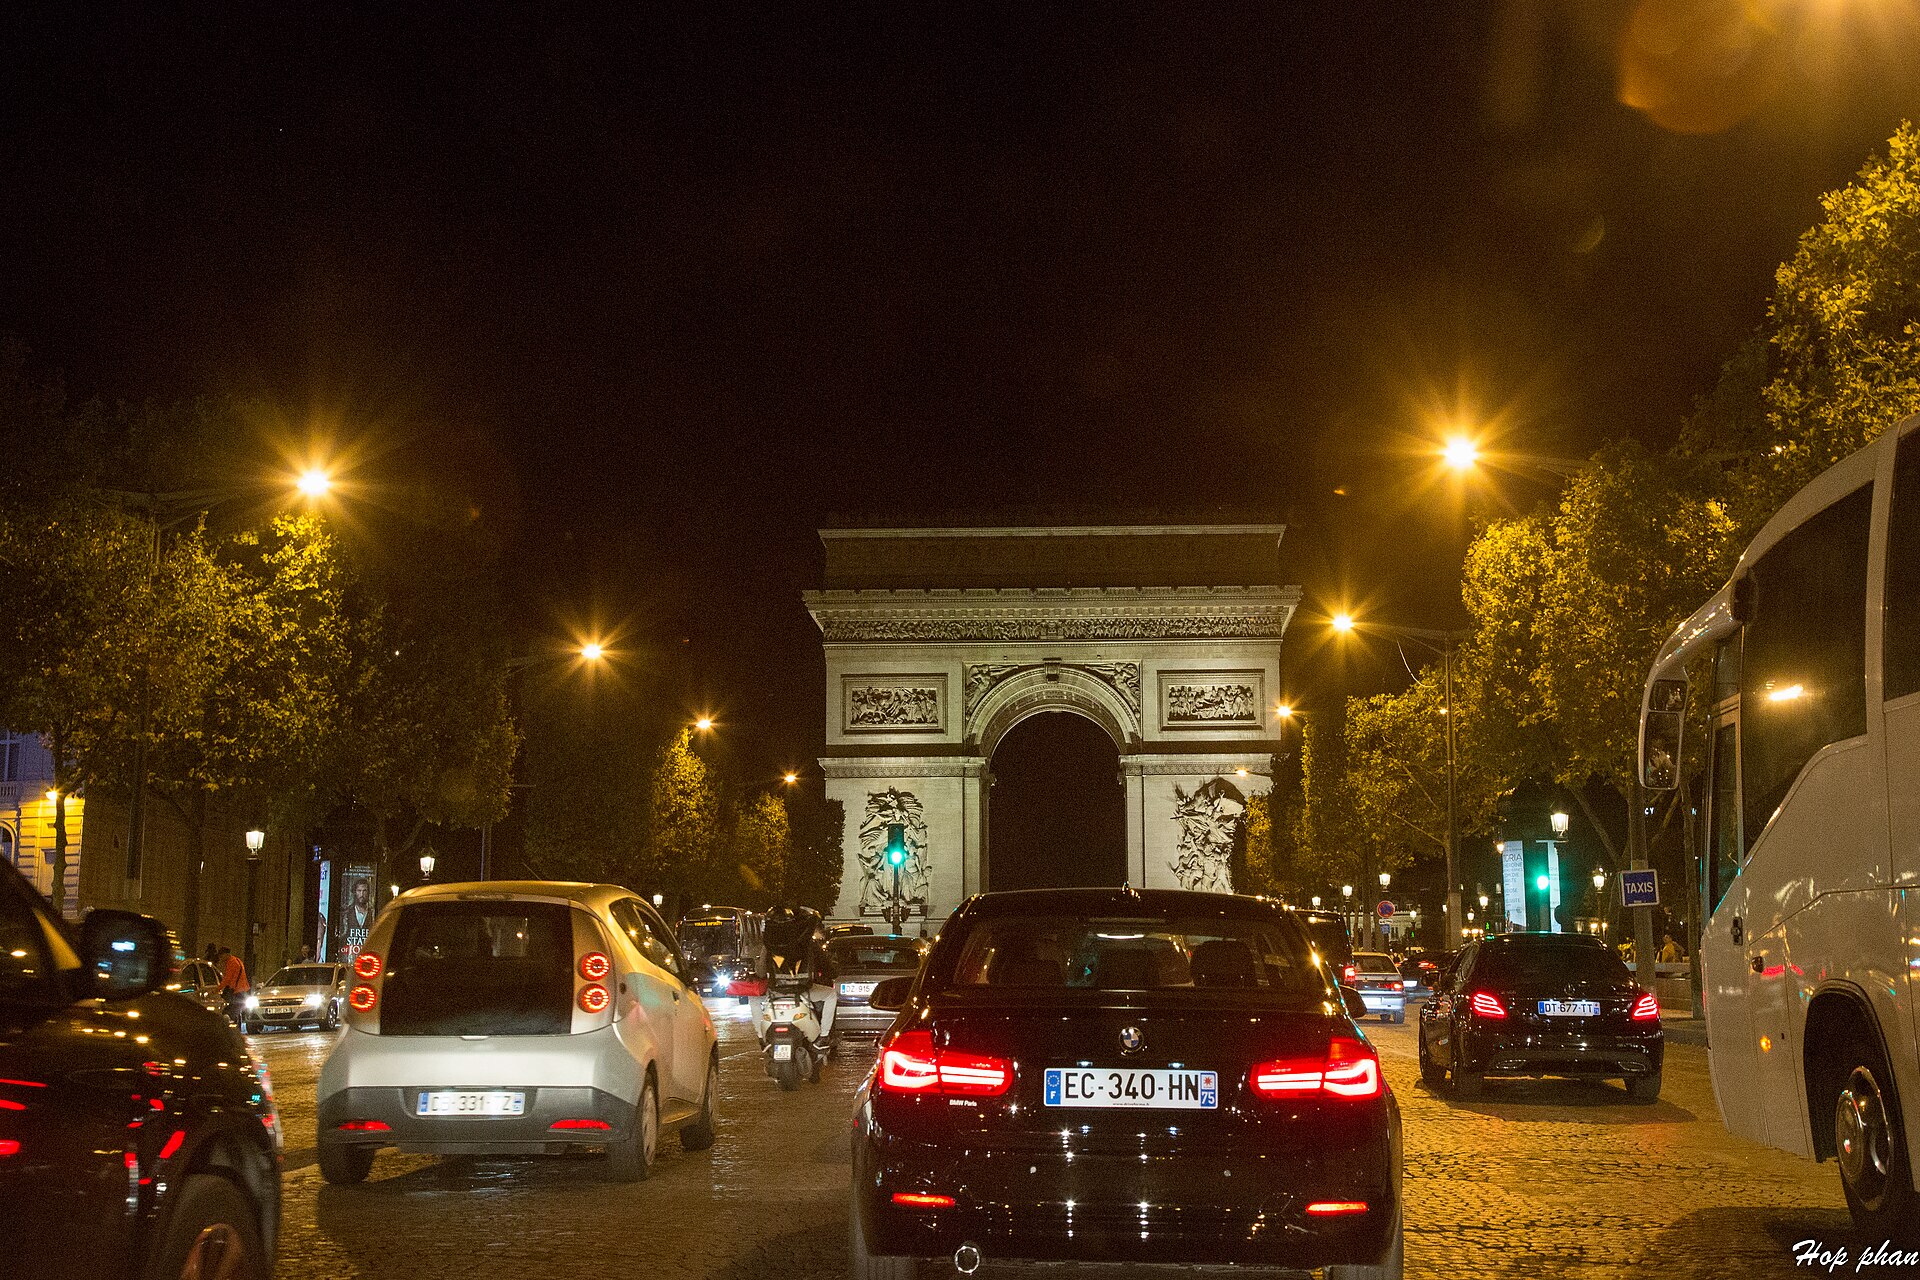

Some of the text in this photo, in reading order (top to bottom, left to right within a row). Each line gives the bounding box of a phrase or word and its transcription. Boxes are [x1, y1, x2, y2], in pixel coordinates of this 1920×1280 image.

[1625, 881, 1654, 894] TAXIS
[346, 937, 368, 946] STAT
[348, 945, 362, 955] JO
[1544, 1003, 1593, 1013] DT-677-TT
[1065, 1072, 1199, 1101] EC-340-HN
[1050, 1091, 1057, 1100] F
[1201, 1091, 1216, 1105] 75
